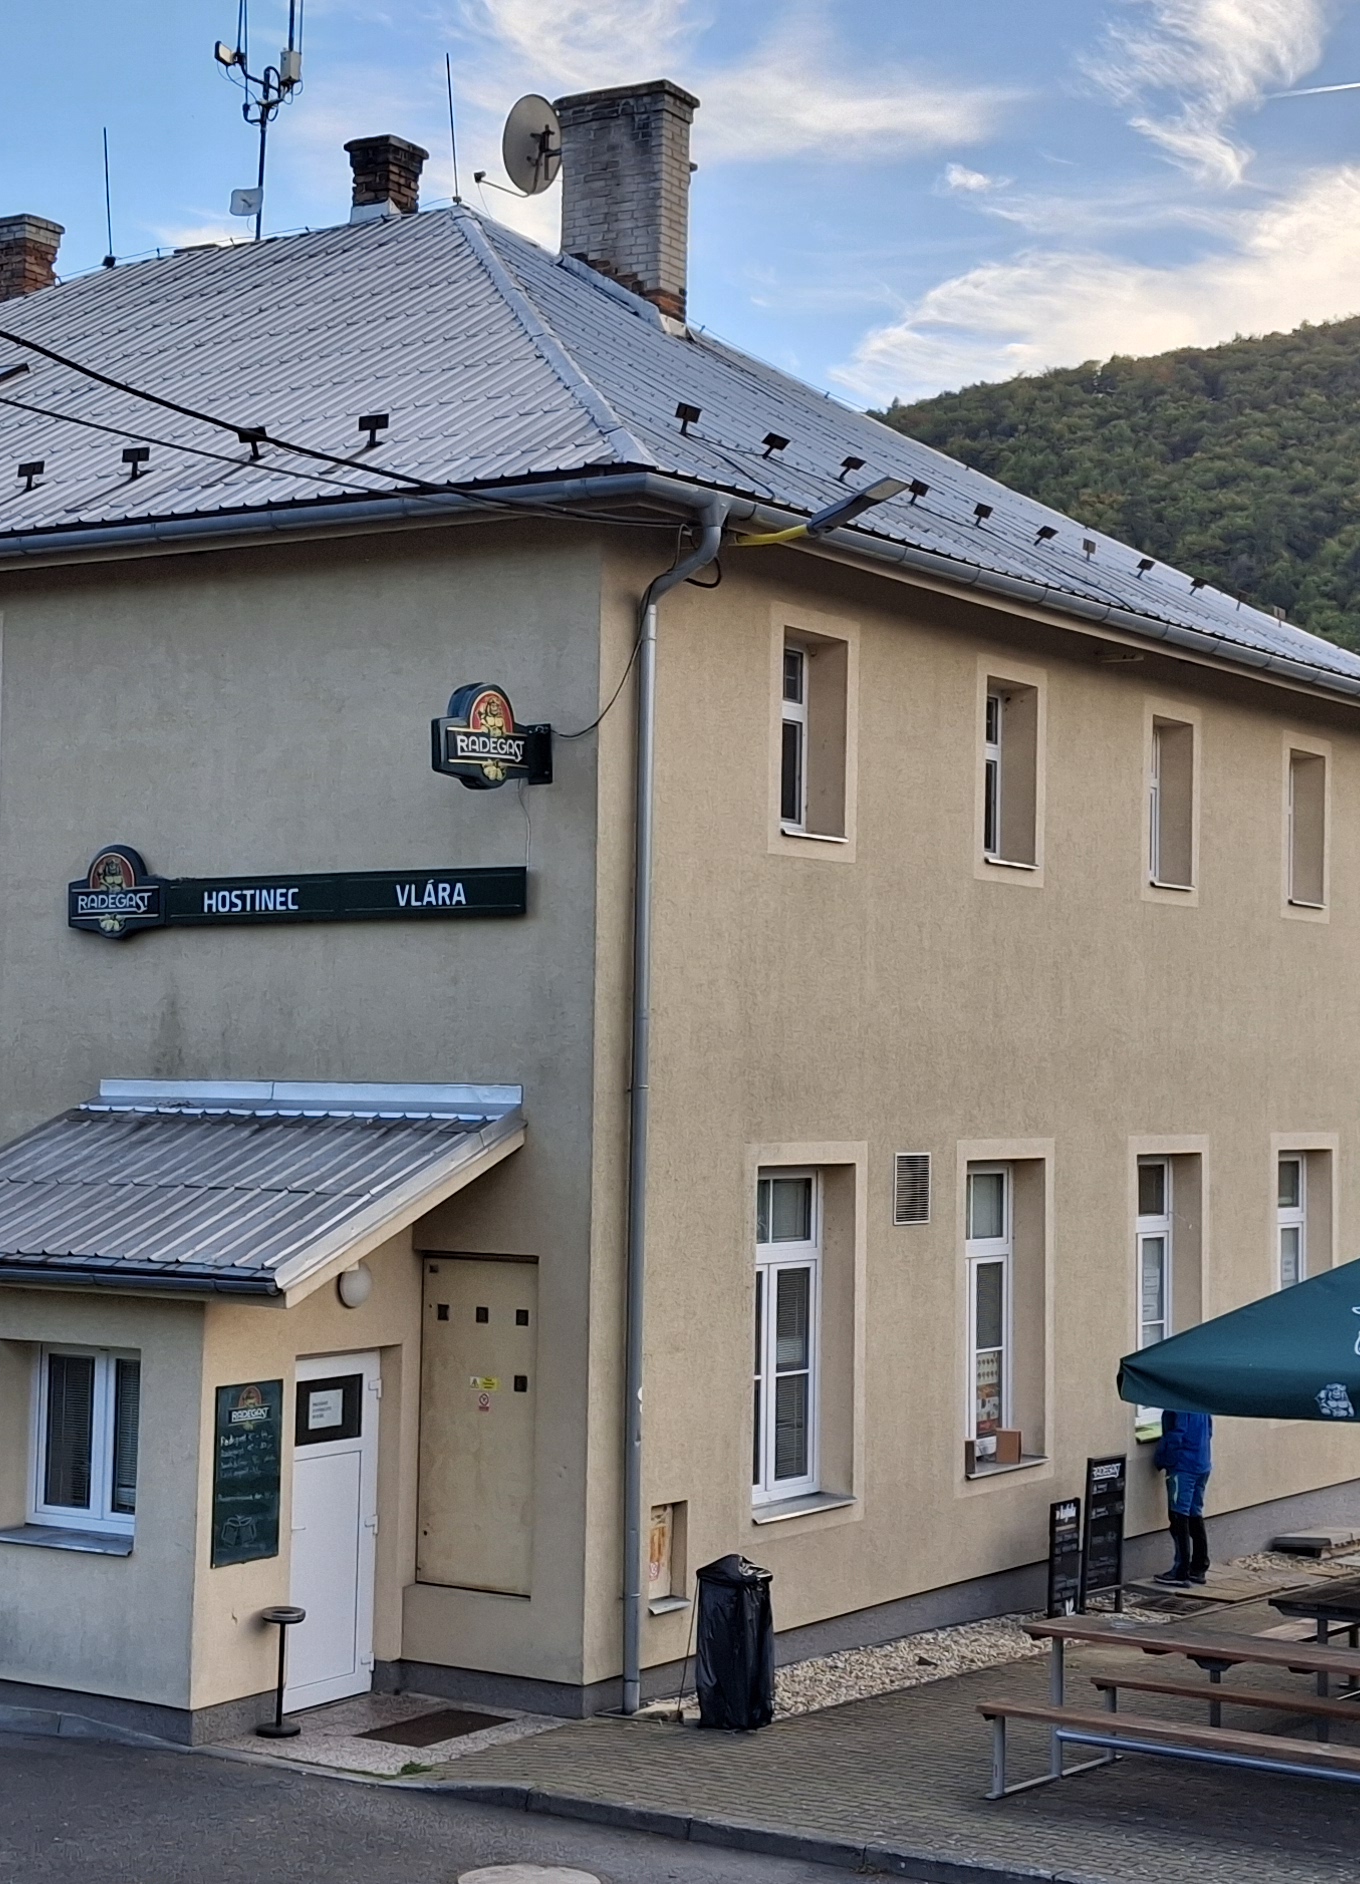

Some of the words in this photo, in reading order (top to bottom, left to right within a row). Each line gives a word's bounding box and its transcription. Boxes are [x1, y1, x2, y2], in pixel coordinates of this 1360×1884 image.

[456, 735, 525, 763] RADEGAST
[78, 892, 153, 914] RADEGAST
[203, 888, 300, 913] HOSTINEC
[395, 879, 467, 907] VLÁRA
